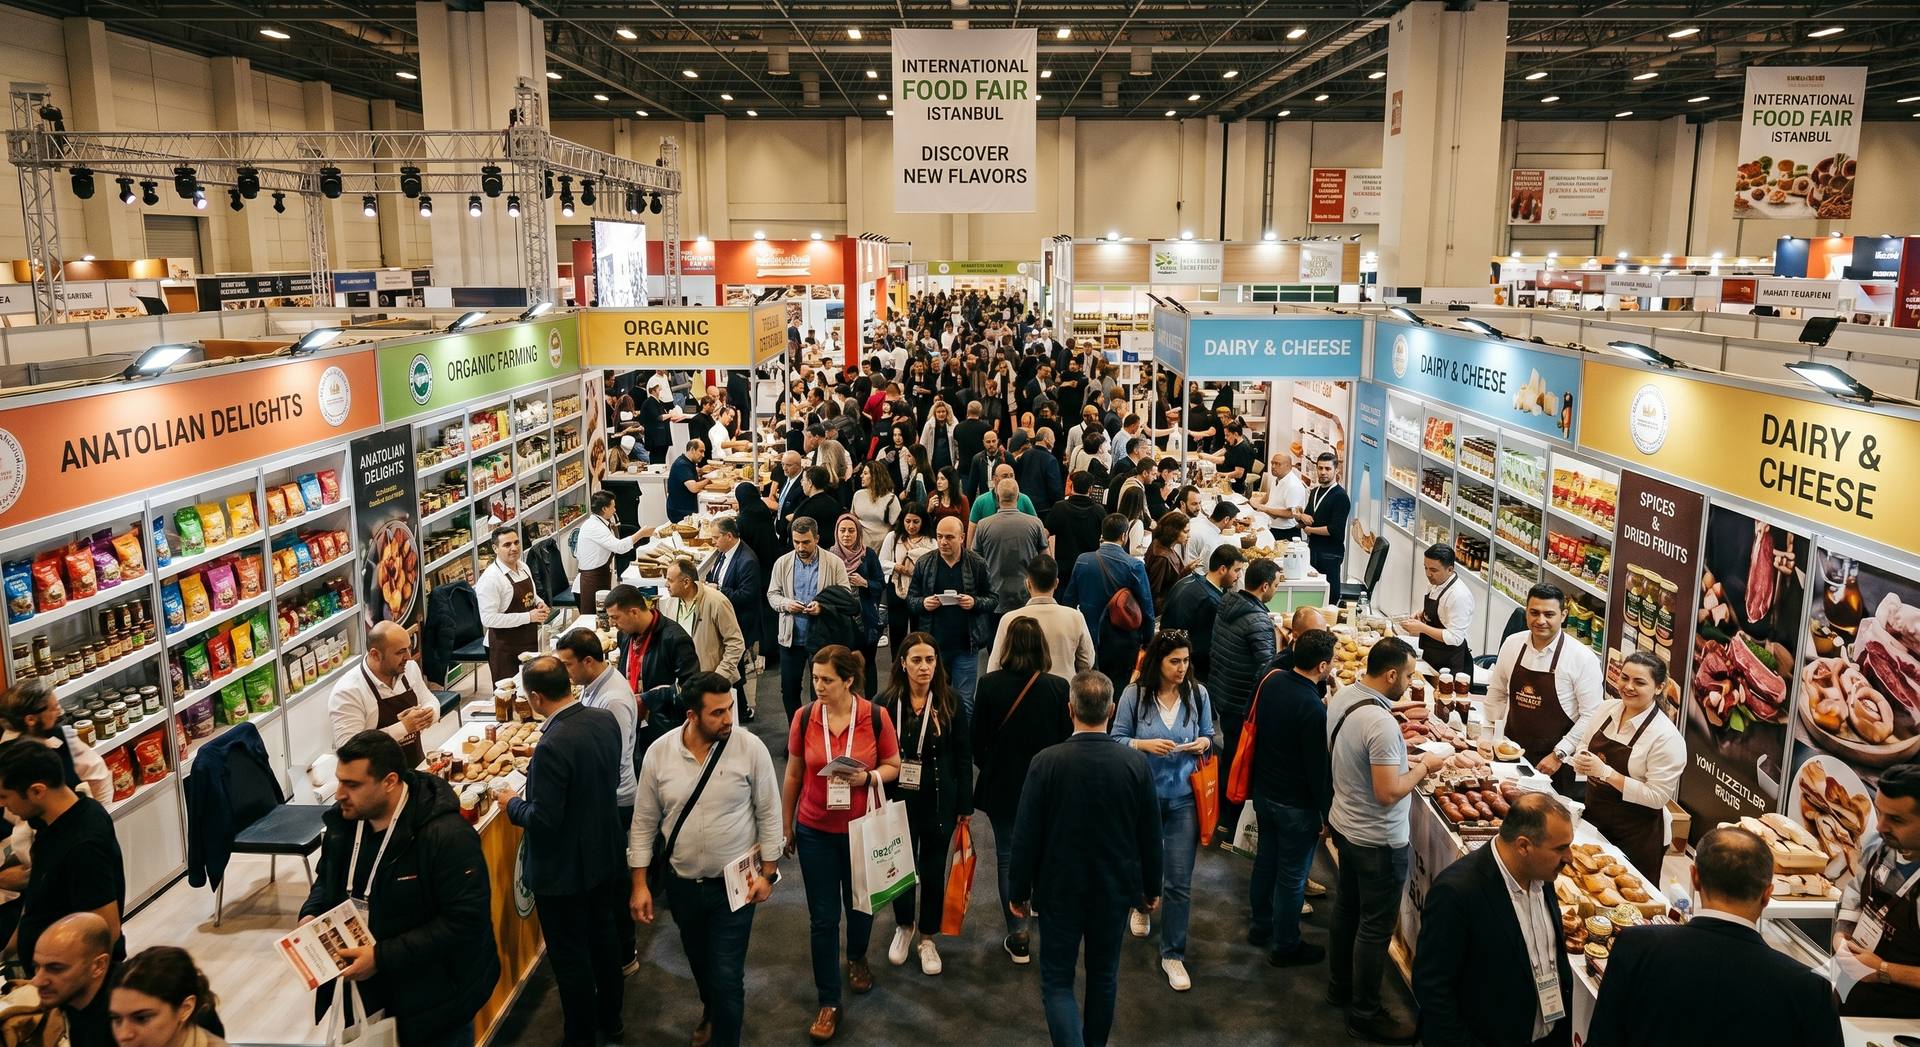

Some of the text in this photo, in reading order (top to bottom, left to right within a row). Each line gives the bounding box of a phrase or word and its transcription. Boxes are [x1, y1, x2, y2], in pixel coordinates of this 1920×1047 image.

[902, 59, 1029, 73] INTERNATIONAL
[902, 79, 1028, 100] FOOD FAIR
[1753, 93, 1855, 106] INTERNATIONAL
[927, 106, 1004, 120] ISTANBUL
[1752, 110, 1853, 126] FOOD FAIR
[1771, 131, 1832, 143] ISTANBUL
[922, 146, 1009, 161] DISCOVER
[903, 168, 1027, 184] NEW FLAVORS
[623, 319, 709, 337] ORGANIC
[625, 341, 710, 357] FARMING
[1204, 339, 1352, 356] DAIRY & CHEESE
[447, 344, 538, 382] ORGANIC FARMING
[1420, 353, 1507, 395] DAIRY & CHEESE
[61, 412, 206, 473] ANATOLIAN
[212, 393, 303, 438] DELIGHTS
[1761, 413, 1881, 472] DAIRY &
[359, 443, 405, 470] ANATOLIAN
[364, 460, 405, 486] DELIGHTS
[1759, 457, 1877, 520] CHEESE
[1640, 491, 1675, 518] SPICES
[1651, 516, 1660, 531] &
[1624, 523, 1688, 564] DRIED FRUITS
